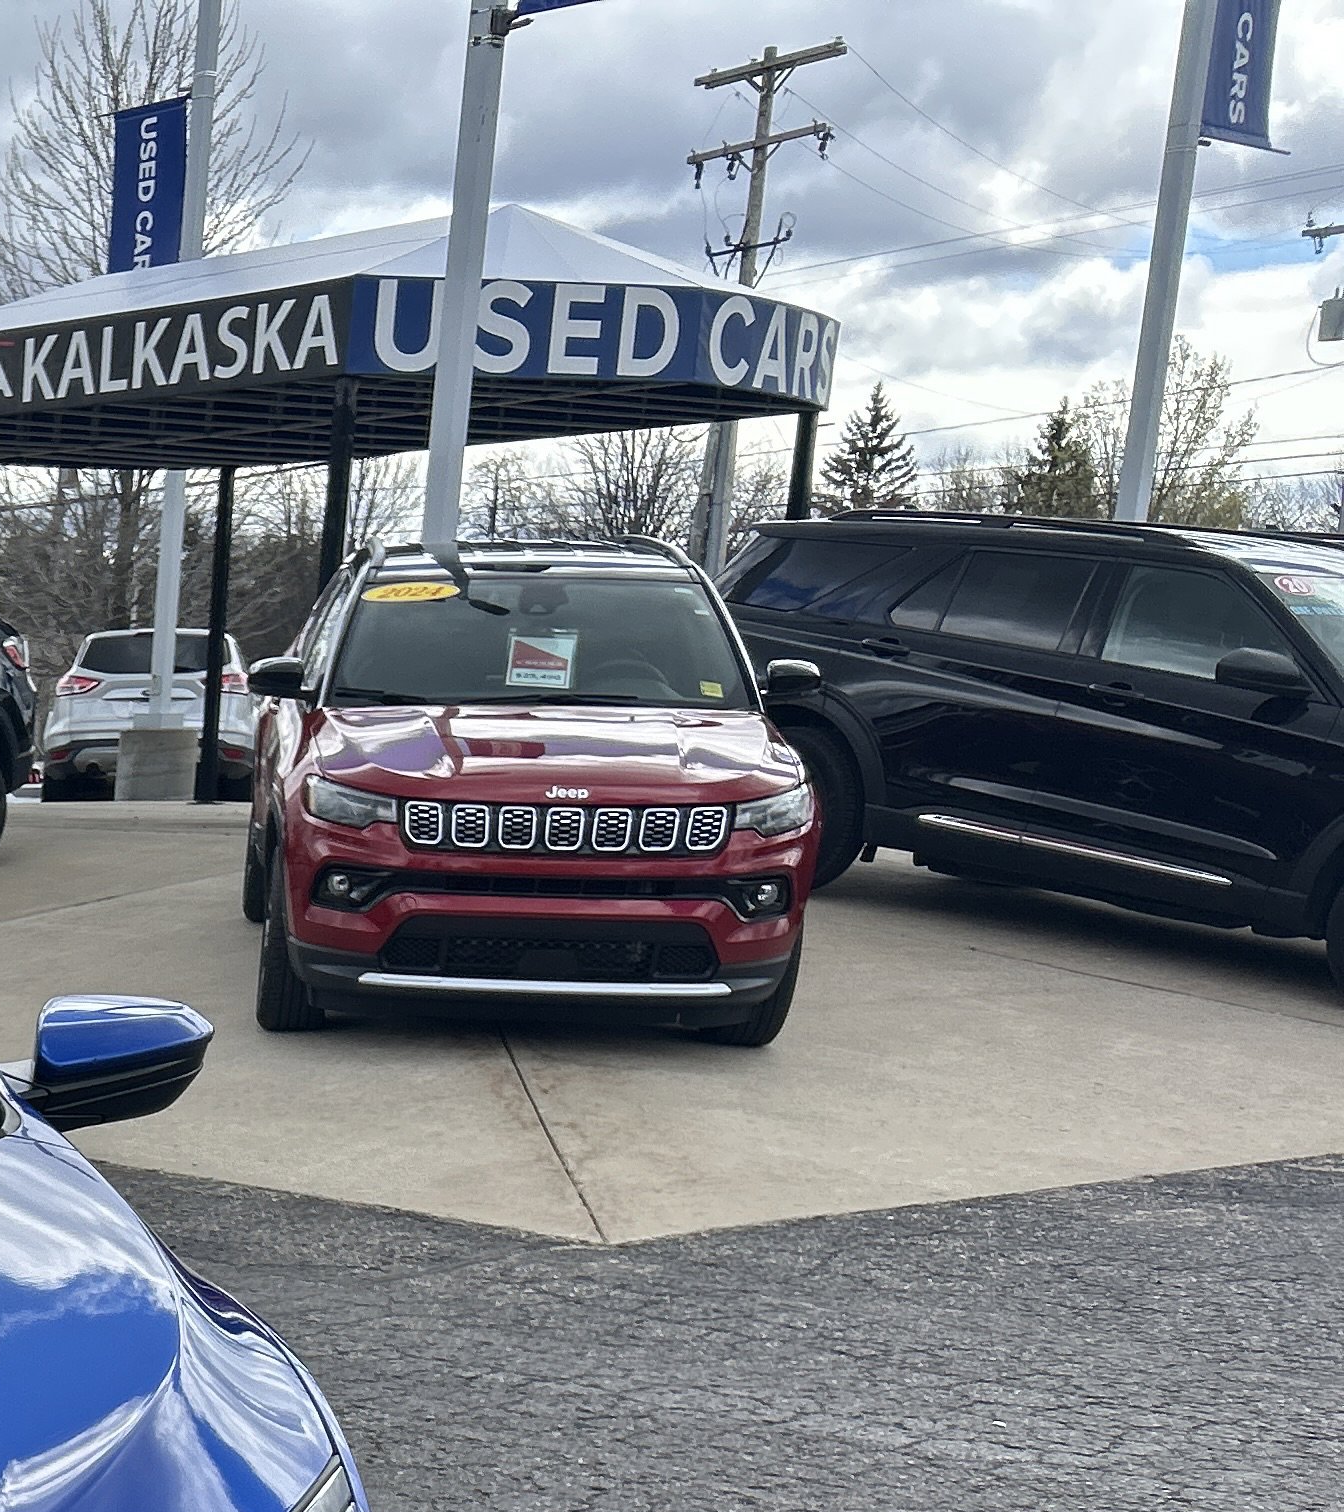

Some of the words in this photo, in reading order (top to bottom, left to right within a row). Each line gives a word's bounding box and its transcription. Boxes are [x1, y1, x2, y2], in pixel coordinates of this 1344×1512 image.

[1229, 12, 1253, 124] CARS
[137, 116, 158, 203] USED
[133, 212, 154, 272] CAR
[21, 293, 340, 404] KALKASKA
[373, 277, 681, 378] USED
[708, 294, 838, 401] CARS
[1282, 578, 1309, 593] 20
[544, 784, 590, 800] Jeep
